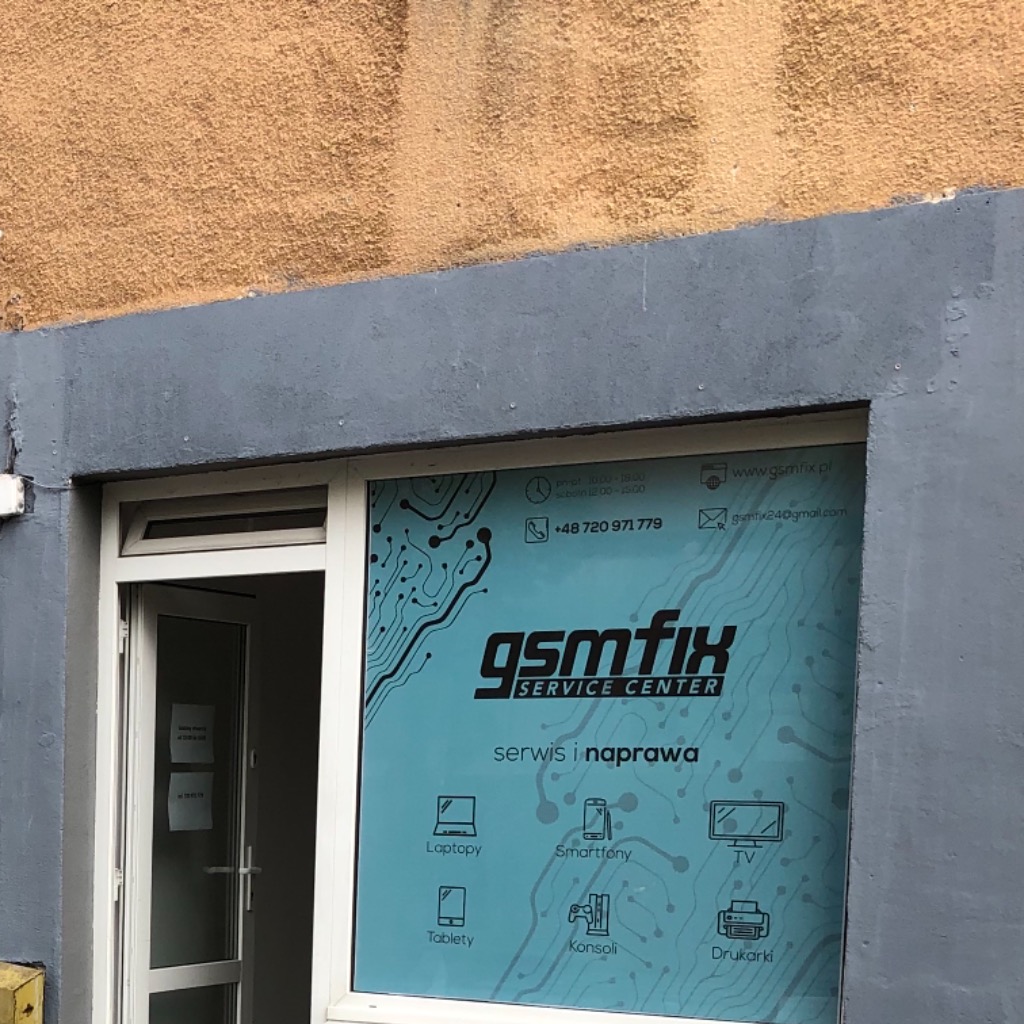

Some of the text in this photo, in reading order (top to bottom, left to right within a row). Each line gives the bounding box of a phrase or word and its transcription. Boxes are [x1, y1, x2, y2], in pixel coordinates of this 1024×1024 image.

[555, 517, 662, 535] +48 720 971 779
[474, 609, 737, 699] gsmfix
[518, 678, 718, 697] SERVICE CENTER
[494, 742, 566, 762] serwis
[584, 746, 699, 767] naprawa
[426, 841, 482, 857] Laptopy
[556, 845, 632, 862] Smartfony
[734, 850, 756, 864] TV
[427, 930, 475, 948] Tablety
[569, 940, 618, 955] Konsoli
[711, 946, 773, 963] Drukarki
